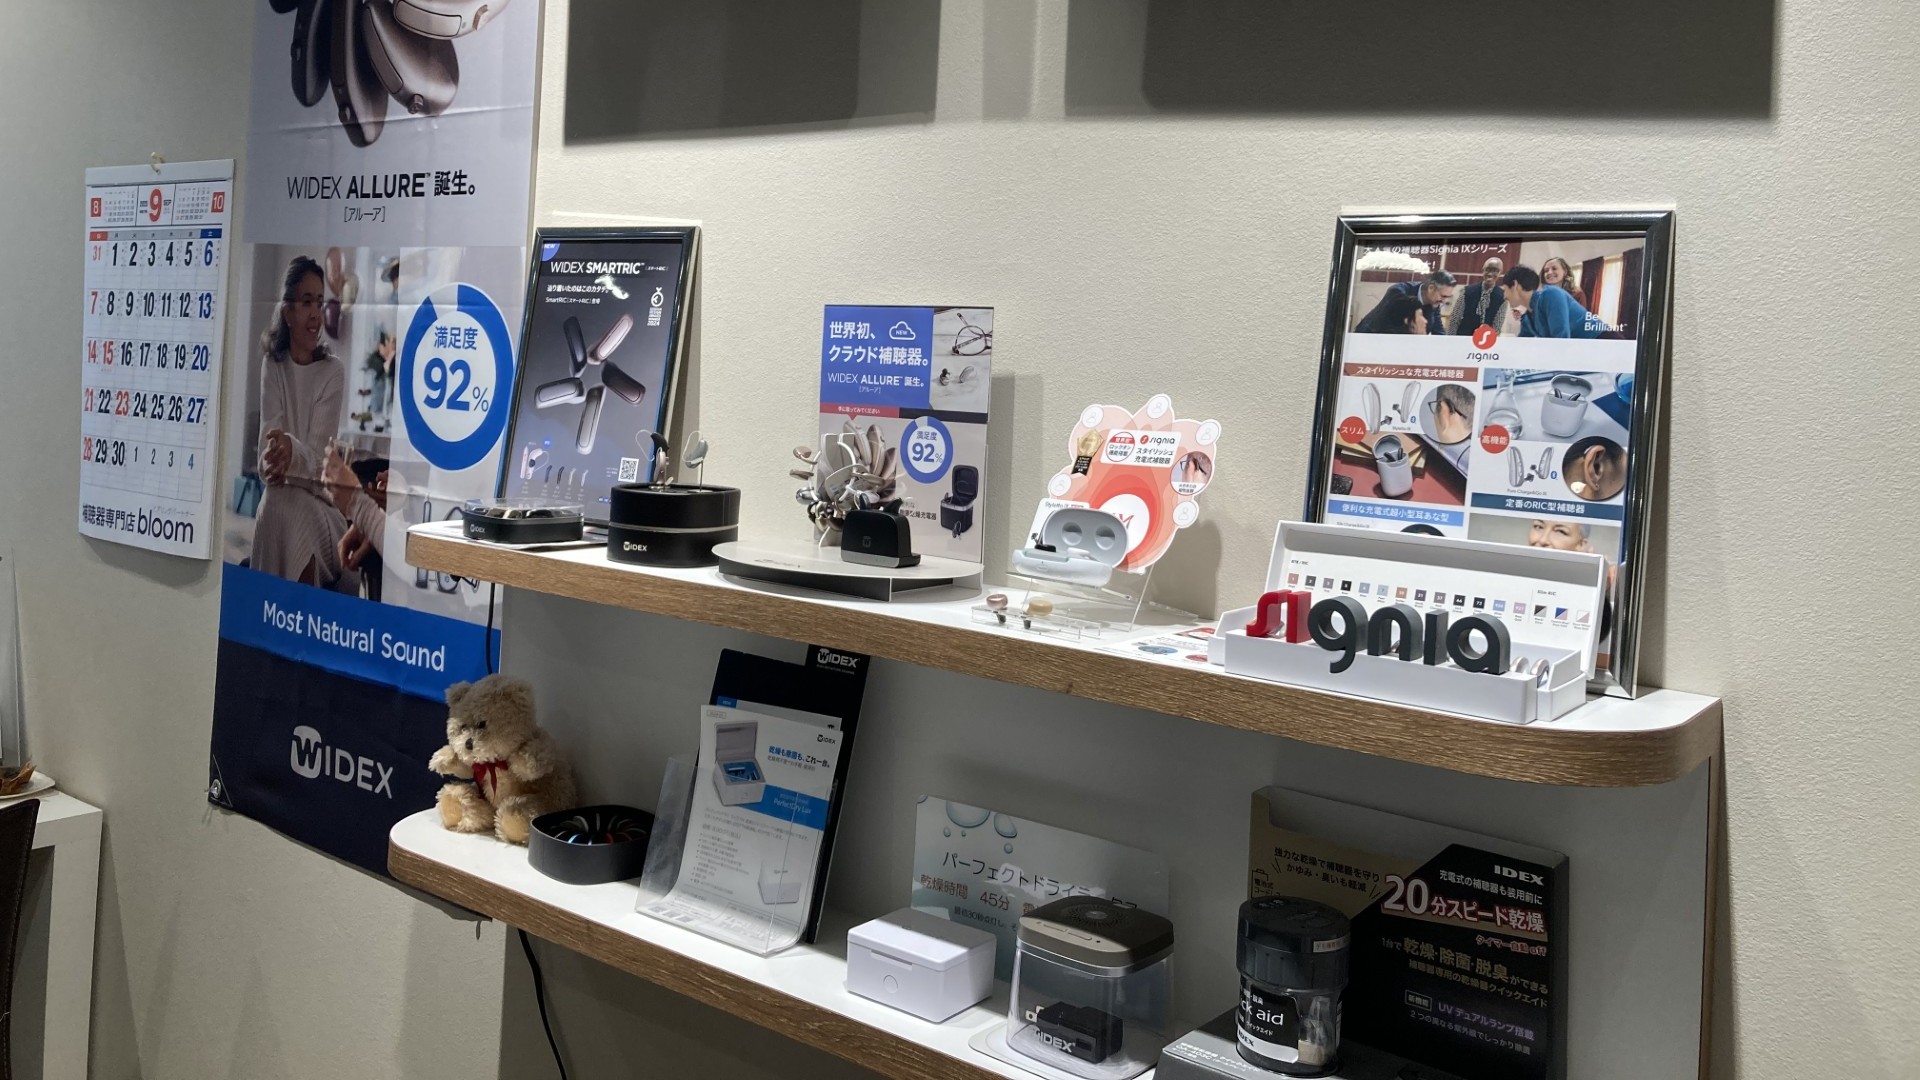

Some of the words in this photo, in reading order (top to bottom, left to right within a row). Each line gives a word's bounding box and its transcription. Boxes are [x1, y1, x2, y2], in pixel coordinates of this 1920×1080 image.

[286, 176, 342, 200] WIDEX
[434, 169, 476, 196] 誕生。
[149, 188, 162, 222] 9
[93, 246, 102, 260] 31
[112, 243, 118, 266] 1
[129, 242, 137, 266] 2
[148, 242, 155, 266] 3
[166, 242, 174, 266] 4
[185, 242, 193, 266] 5
[204, 241, 213, 266] 6
[1461, 244, 1509, 254] IXシリーズ
[550, 262, 584, 274] WIDEX
[91, 292, 98, 314] 7
[107, 291, 114, 316] 8
[126, 292, 134, 316] 9
[144, 292, 155, 317] 10
[162, 292, 172, 317] 11
[179, 292, 191, 317] 12
[199, 293, 212, 319] 13
[1585, 311, 1599, 321] Be
[434, 326, 478, 350] 満足度
[830, 321, 876, 340] 世界初、
[88, 340, 96, 363] 14
[103, 341, 114, 365] 15
[121, 342, 132, 366] 16
[140, 343, 150, 367] 17
[157, 343, 168, 368] 18
[174, 344, 186, 369] 19
[191, 345, 209, 371] 20
[828, 345, 928, 366] クラウド補聴器。
[1466, 351, 1499, 362] signia
[828, 373, 858, 384] WIDEX
[904, 377, 924, 387] 誕生。
[1356, 366, 1464, 379] スタイリッシュな充電式補聴器
[423, 357, 489, 412] 92%
[84, 388, 94, 412] 21
[98, 389, 111, 414] 22
[115, 391, 129, 416] 23
[133, 392, 147, 417] 24
[151, 394, 164, 420] 25
[168, 396, 182, 422] 26
[187, 397, 205, 423] 27
[916, 431, 937, 441] 満足度
[1340, 426, 1364, 434] スリム
[1149, 437, 1175, 447] signia
[1482, 435, 1507, 446] 高機能
[83, 437, 92, 461] 28
[95, 439, 107, 464] 29
[112, 441, 125, 466] 30
[134, 446, 138, 462] 1
[151, 448, 156, 465] 2
[168, 451, 173, 467] 3
[188, 454, 194, 470] 4
[912, 443, 943, 463] 92%
[1134, 456, 1171, 464] 充電式補聴器
[1136, 448, 1174, 456] スタイリッシュ
[1342, 504, 1449, 522] 便利な充電式超小型耳あな型
[1505, 498, 1585, 514] 定番のRIC型補聴器
[82, 503, 136, 532] 補聴器専門店
[138, 507, 194, 544] bloom
[470, 524, 485, 533] WIDEX
[623, 541, 648, 552] WIDEX
[262, 600, 304, 634] Most
[307, 616, 374, 654] Natural
[381, 632, 445, 672] Sound
[1246, 589, 1511, 674] signia
[817, 648, 860, 668] WIDEX
[817, 735, 836, 745] WIDEX
[290, 725, 394, 800] WIDEX
[1274, 846, 1380, 883] 強力な乾燥で補聴器を守り
[1286, 864, 1367, 892] かゆみ・臭いも軽減
[1494, 864, 1544, 886] IDEX
[920, 874, 968, 899] 乾燥時間
[980, 891, 1010, 911] 45分
[1440, 869, 1543, 905] 充電式の補聴器も装用前に
[1382, 874, 1544, 933] 20分スピード乾燥
[1256, 1008, 1284, 1026] aid
